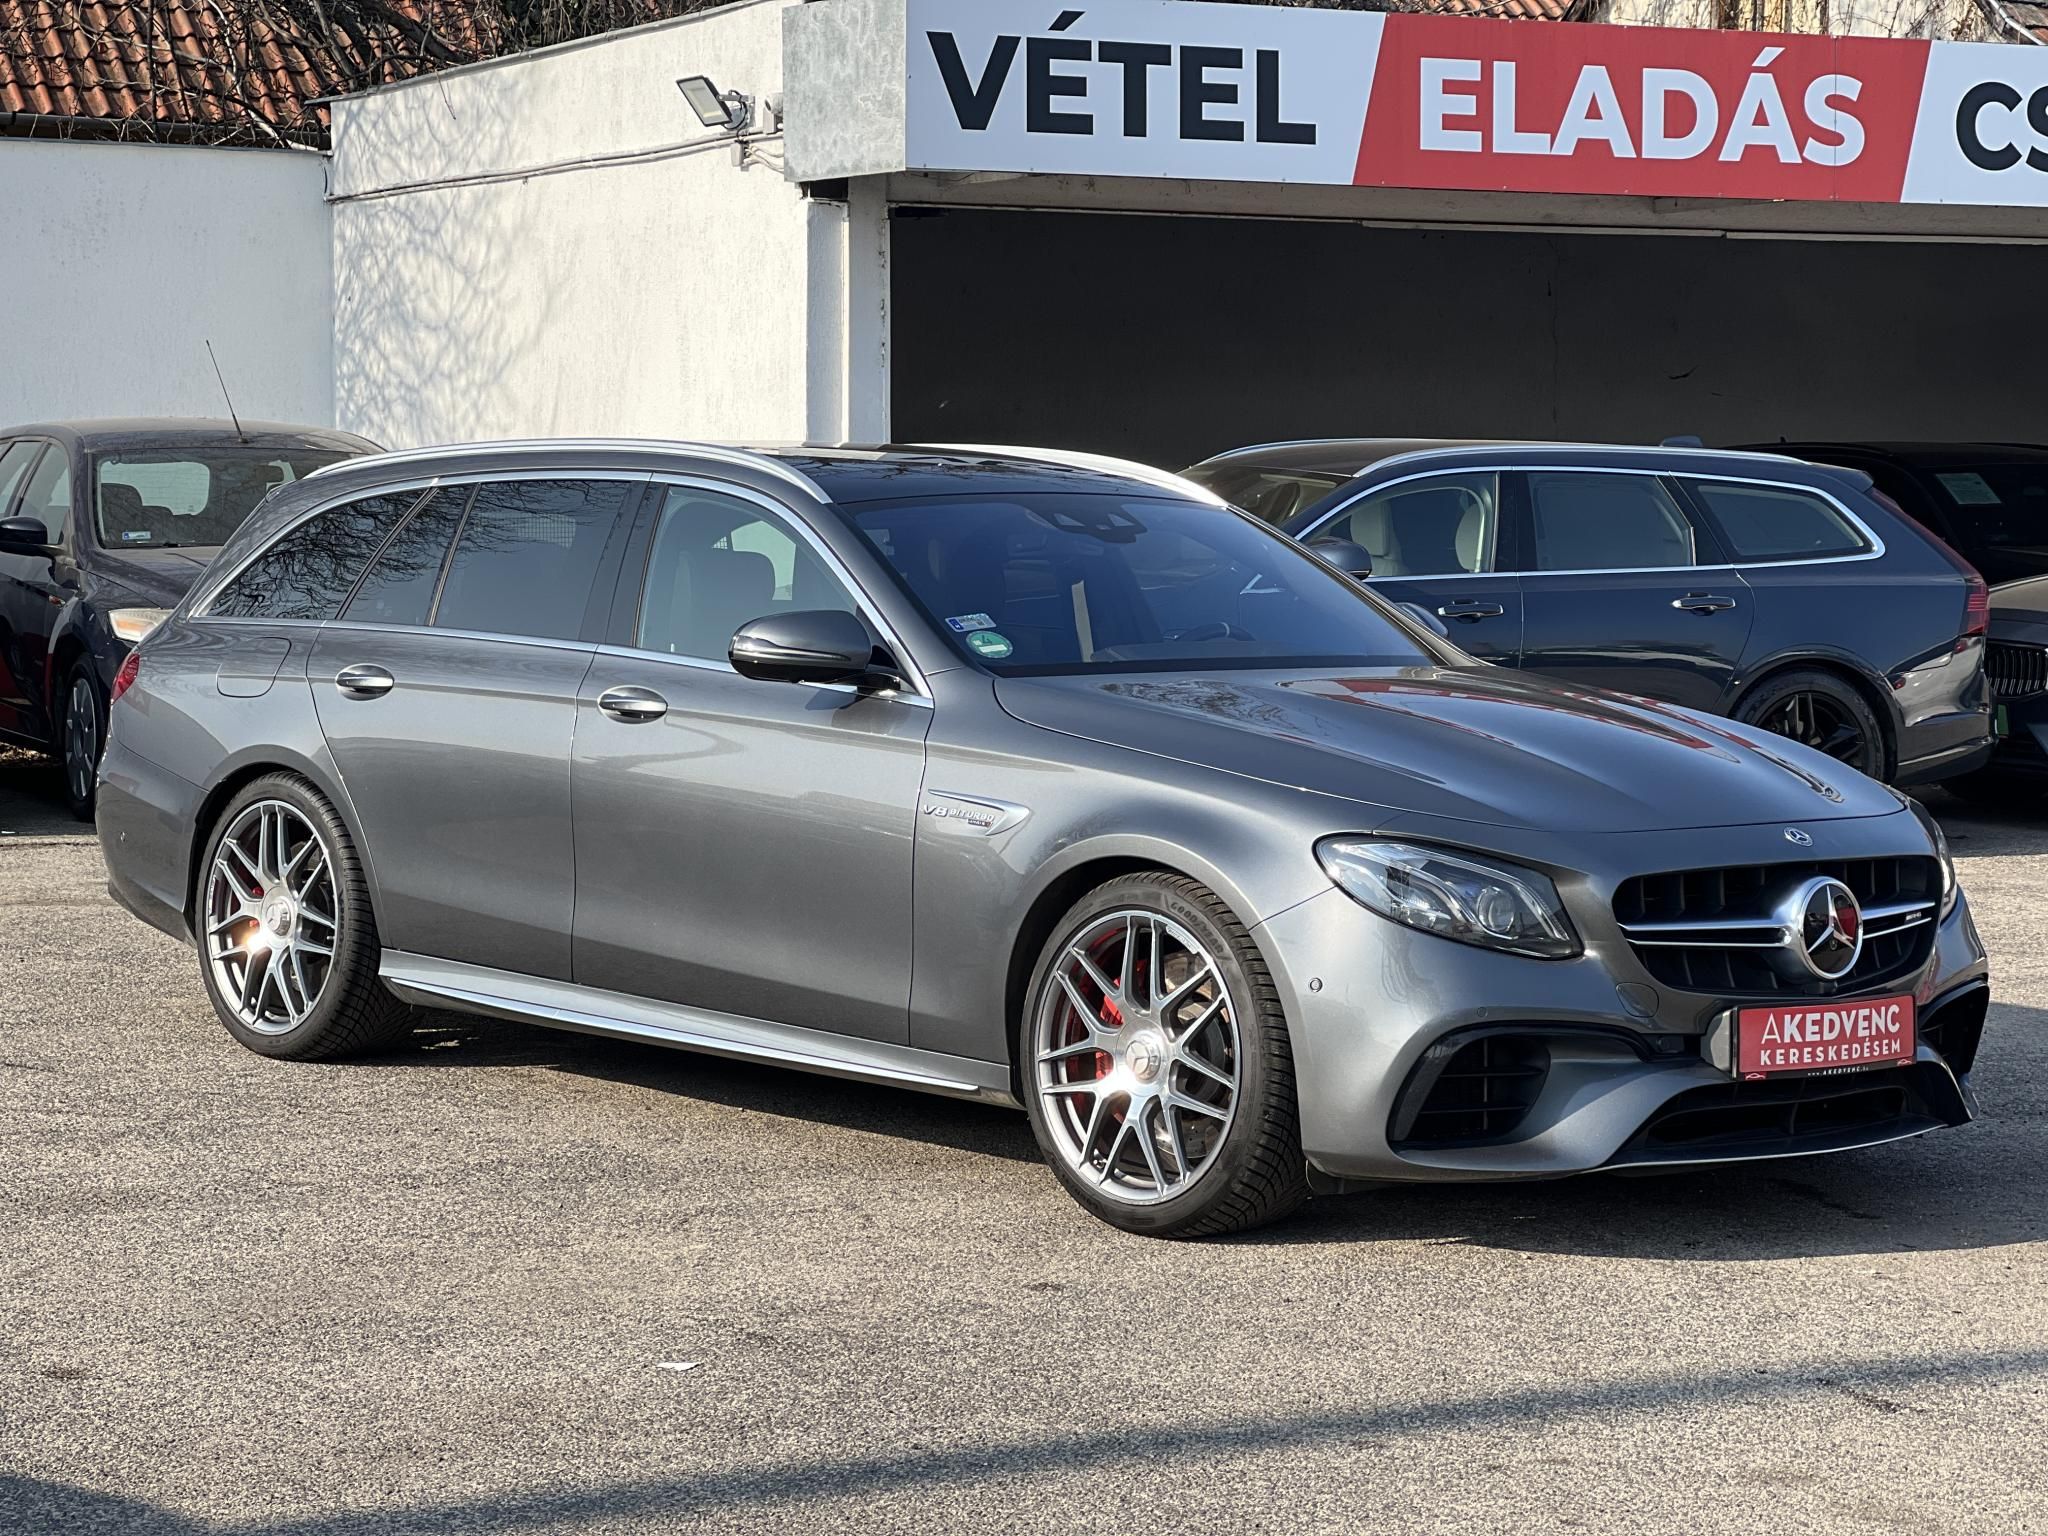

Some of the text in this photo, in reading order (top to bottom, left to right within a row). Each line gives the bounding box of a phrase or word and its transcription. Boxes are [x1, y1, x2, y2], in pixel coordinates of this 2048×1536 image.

[926, 10, 1316, 145] VÉTEL
[1419, 47, 1866, 166] ELADÁS
[924, 804, 995, 821] V8 BITURBO
[1760, 1037, 1900, 1066] KERESKEDÉSEM
